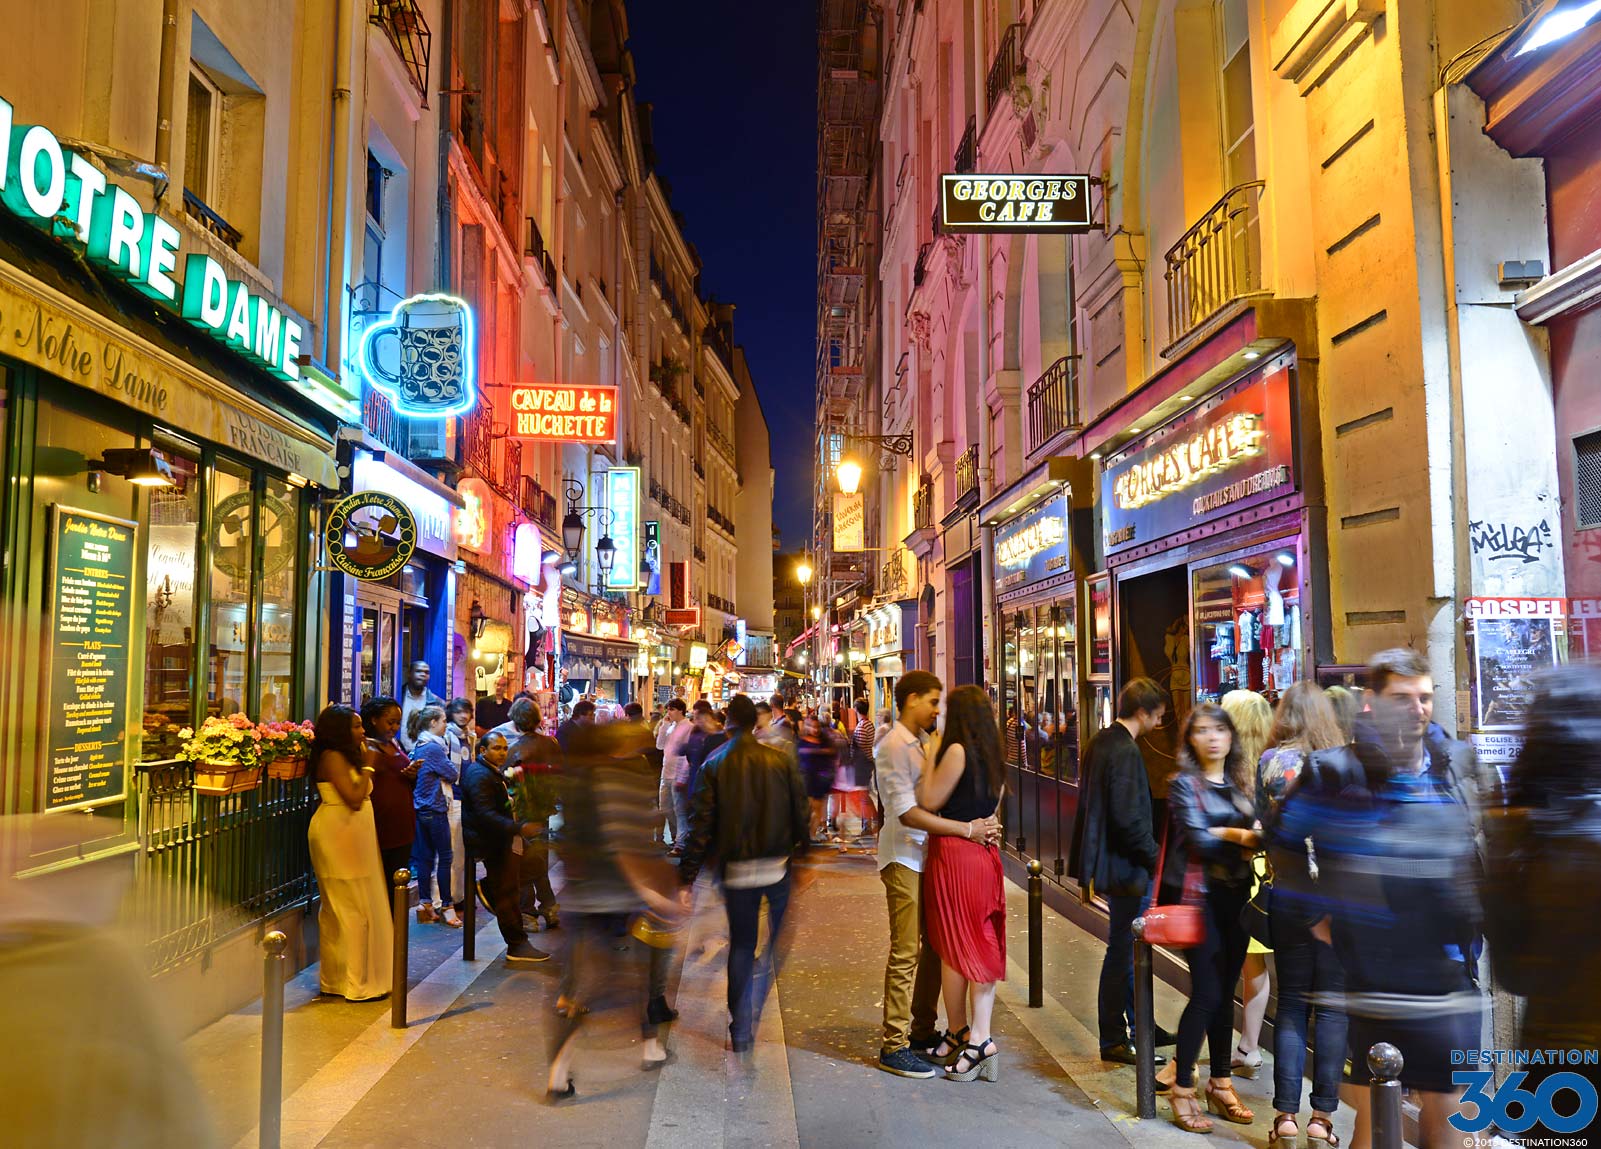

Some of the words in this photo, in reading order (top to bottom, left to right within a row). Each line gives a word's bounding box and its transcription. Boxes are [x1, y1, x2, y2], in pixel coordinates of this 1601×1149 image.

[953, 180, 1077, 200] GEORGES
[979, 201, 1053, 221] CAFE
[0, 97, 181, 301] OTRE
[196, 254, 302, 381] DAME
[15, 303, 92, 376] Notre
[103, 340, 167, 411] Dame
[512, 388, 576, 411] CAVEAU
[579, 391, 597, 412] de
[600, 392, 612, 412] la
[517, 413, 607, 437] HUCHETTE
[337, 498, 361, 519] Jardin
[361, 493, 384, 505] Notre
[384, 498, 404, 518] Dame
[612, 477, 631, 580] METEORA
[336, 553, 364, 577] Cuisine
[363, 554, 404, 578] Française
[1465, 599, 1565, 619] GOSPEL
[84, 641, 102, 650] PLATS
